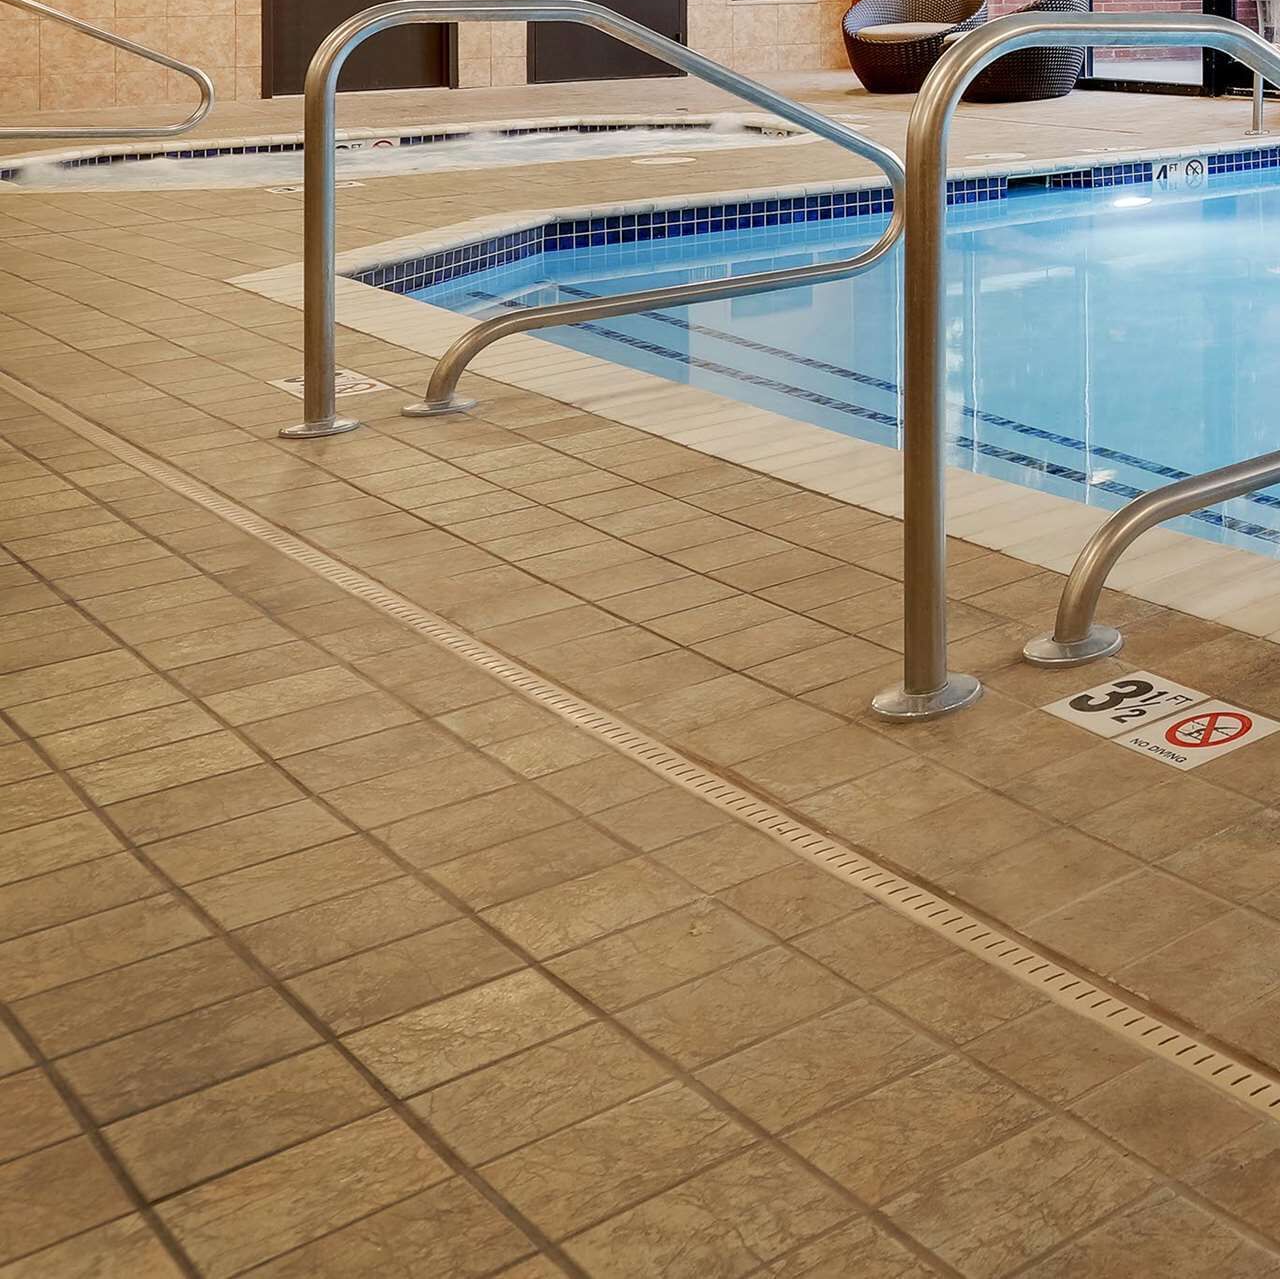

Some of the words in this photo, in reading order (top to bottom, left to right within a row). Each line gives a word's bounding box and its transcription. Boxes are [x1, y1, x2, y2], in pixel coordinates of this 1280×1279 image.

[1169, 163, 1178, 172] FT
[1165, 694, 1194, 706] FT
[1130, 738, 1147, 747] NO
[1147, 745, 1188, 763] DIVING
